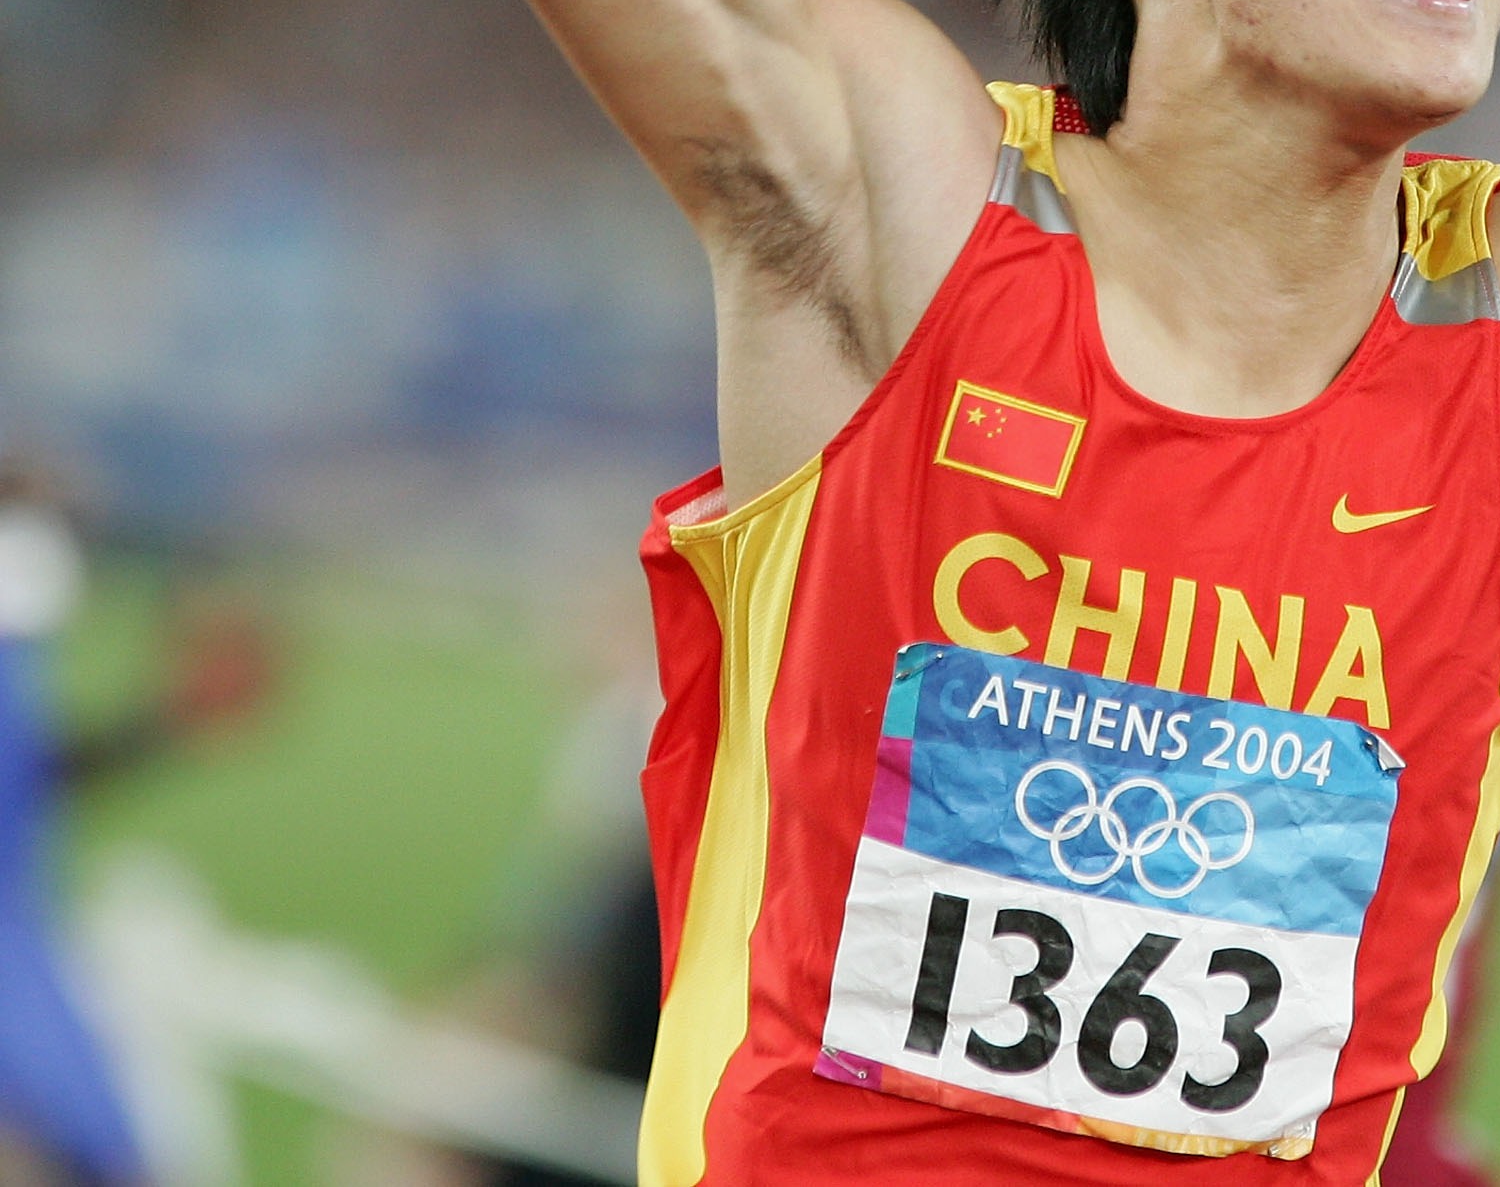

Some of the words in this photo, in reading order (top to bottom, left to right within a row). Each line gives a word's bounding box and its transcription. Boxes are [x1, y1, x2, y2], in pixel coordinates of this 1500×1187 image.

[934, 532, 1391, 729] CHINA
[967, 675, 1191, 760] ATHENS
[1201, 720, 1333, 786] 2004
[903, 892, 1283, 1113] 1363
